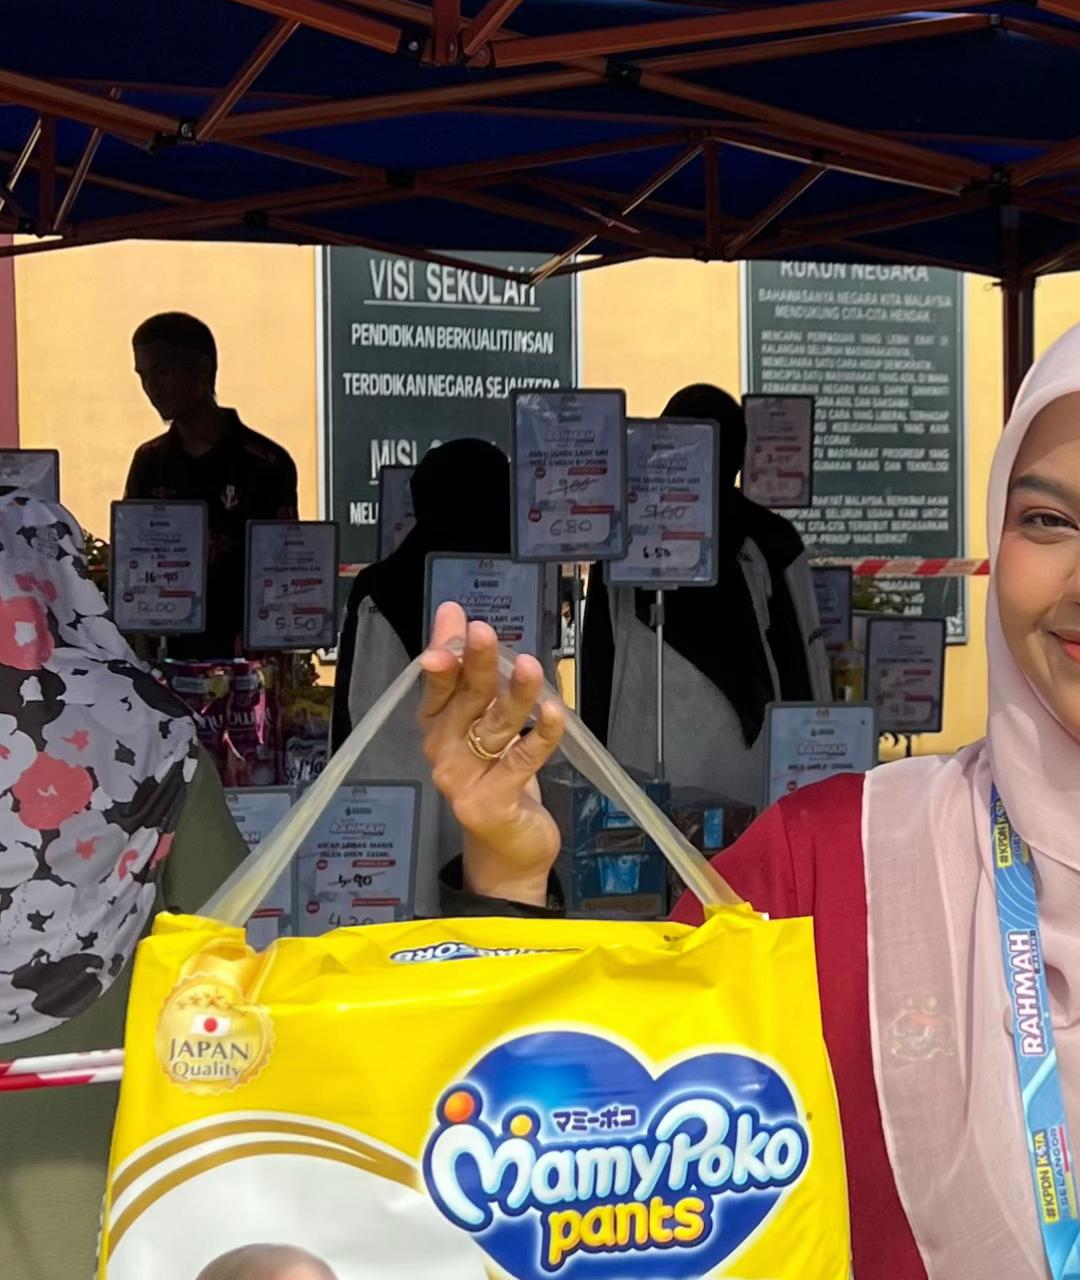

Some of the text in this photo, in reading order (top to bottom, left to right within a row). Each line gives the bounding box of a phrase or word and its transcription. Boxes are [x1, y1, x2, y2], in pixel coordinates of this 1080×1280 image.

[369, 258, 536, 306] VISI SEKOLAH
[851, 264, 930, 282] NEGARA
[351, 323, 554, 355] PENDIDIKAN BERKUALITI INSAN
[343, 372, 427, 397] TERDIDIKAN
[427, 374, 484, 398] NEGARA
[369, 438, 417, 480] MISI
[550, 519, 593, 537] 6.80
[275, 616, 316, 631] 5.50
[1007, 930, 1046, 1056] RAHMAH
[168, 1038, 250, 1062] JAPAN
[172, 1059, 244, 1081] Quality
[552, 1107, 637, 1132] マミーポコ
[430, 1090, 803, 1225] MamyPoko
[1050, 1127, 1069, 1207] SELANGOR
[1039, 1169, 1057, 1219] #KPDN
[547, 1196, 706, 1265] pants
